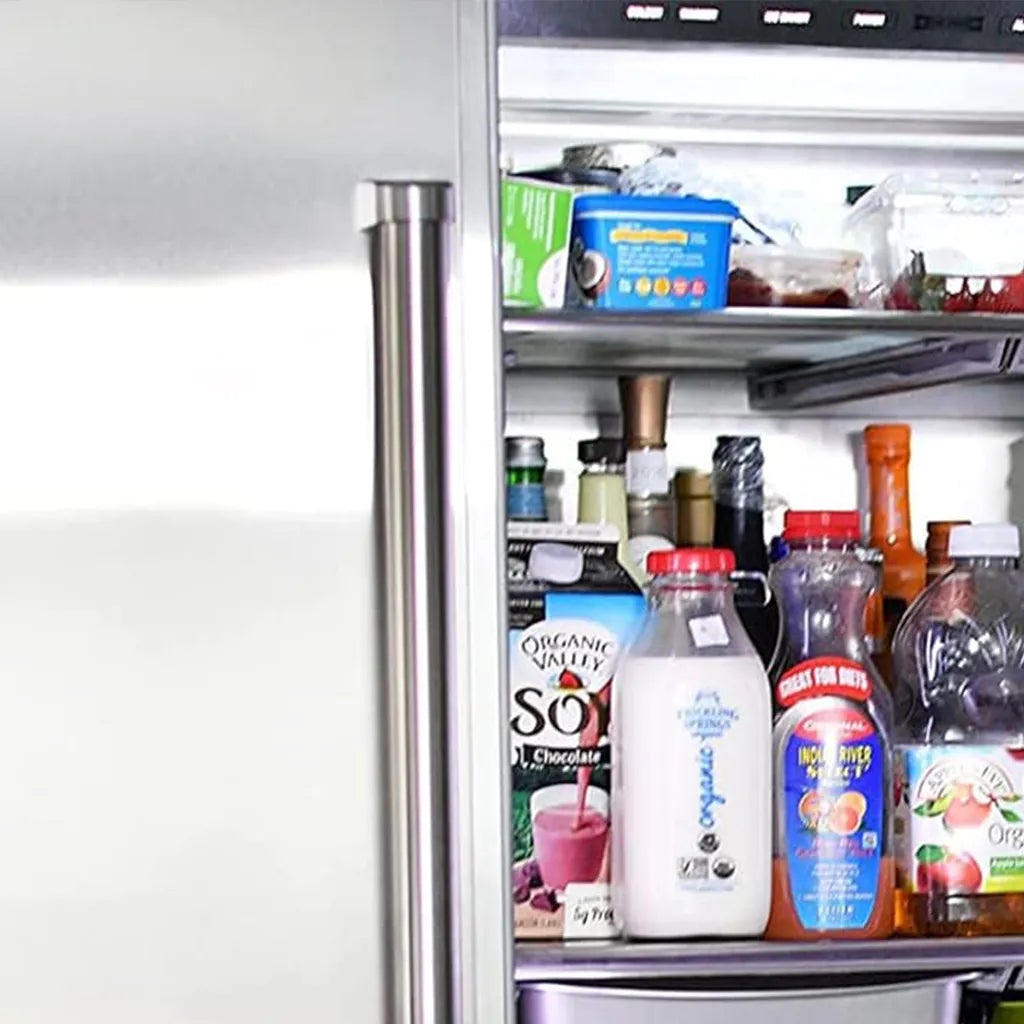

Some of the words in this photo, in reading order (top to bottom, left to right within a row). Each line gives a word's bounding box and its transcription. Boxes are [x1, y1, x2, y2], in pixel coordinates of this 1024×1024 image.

[521, 633, 616, 657] ORGANIC
[533, 653, 604, 671] VALLEY
[533, 748, 602, 765] Chocolate
[699, 746, 726, 829] organic
